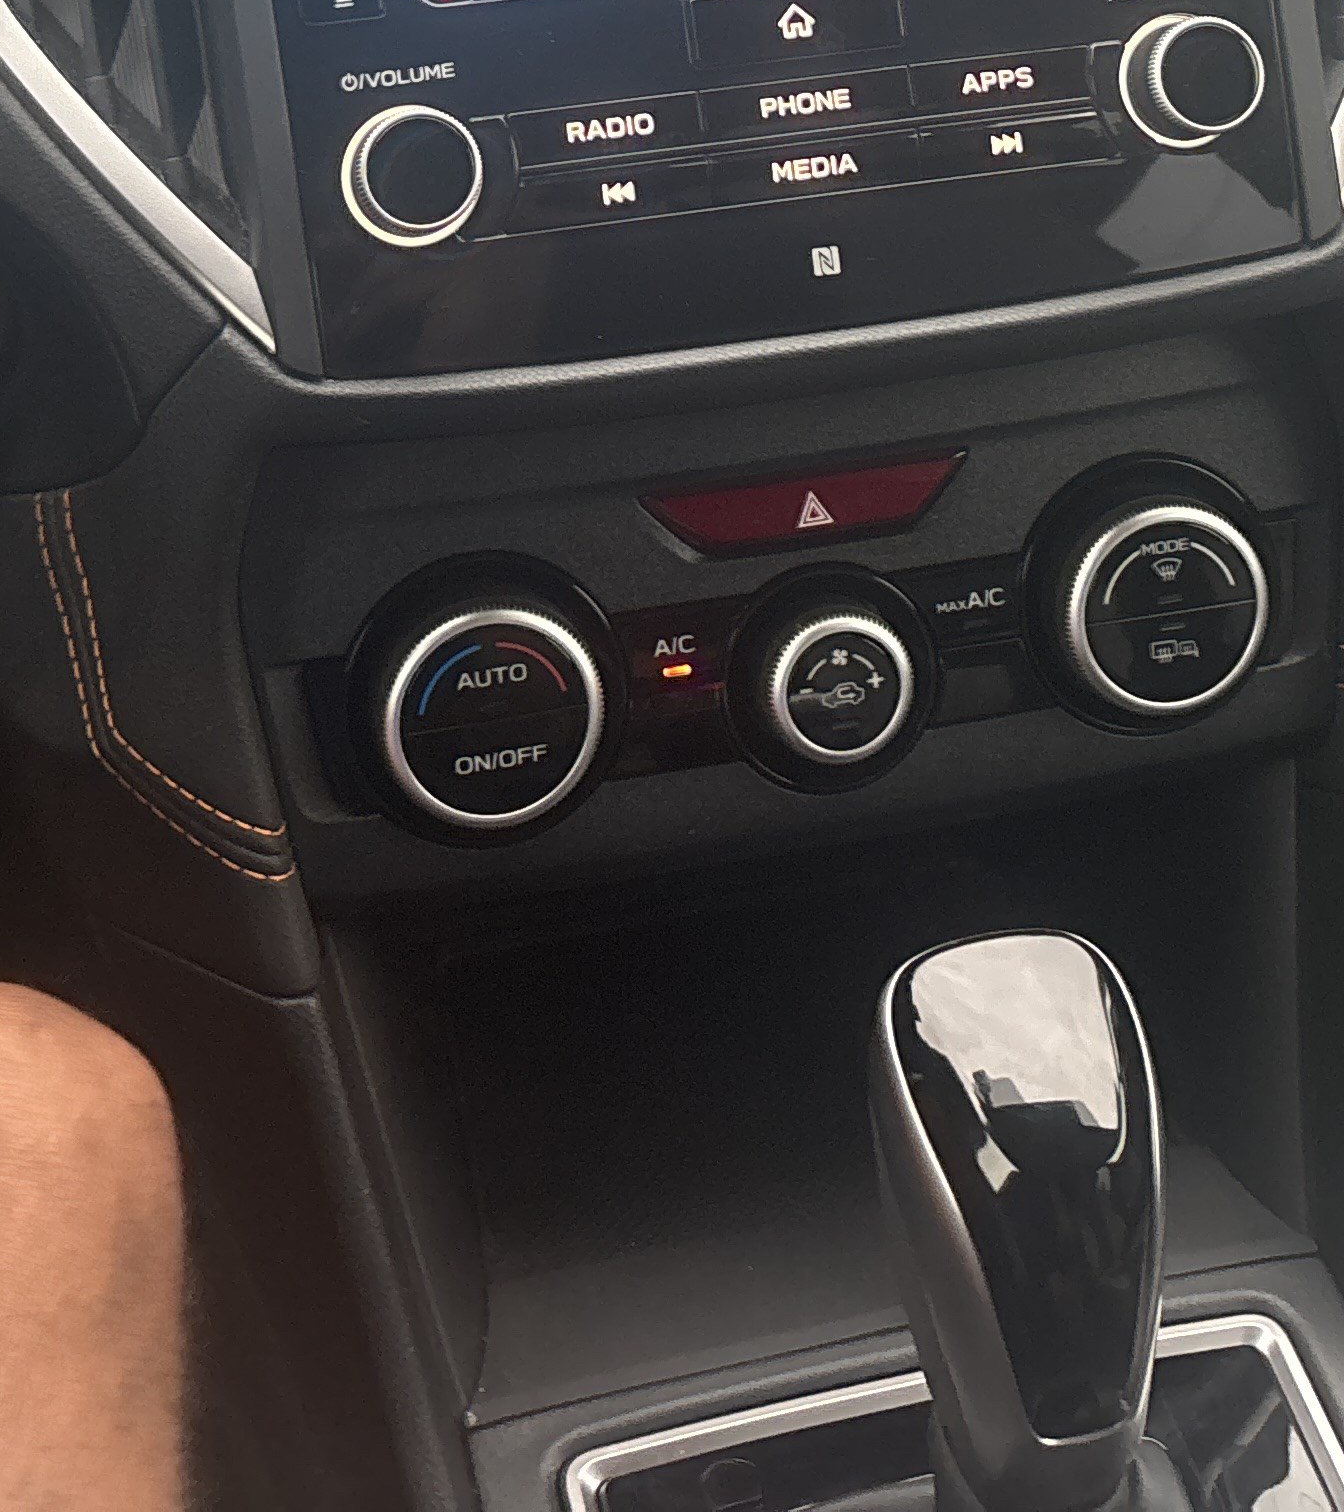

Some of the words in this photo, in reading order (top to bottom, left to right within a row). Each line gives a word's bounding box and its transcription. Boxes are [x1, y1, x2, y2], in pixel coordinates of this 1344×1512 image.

[961, 66, 1035, 95] APPS
[759, 88, 853, 119] PHONE
[565, 112, 656, 144] RADIO
[771, 153, 859, 184] MEDIA
[1139, 537, 1192, 557] MODE
[654, 634, 697, 659] A/C
[457, 662, 529, 692] AUTO
[454, 743, 550, 777] ON/OFF
